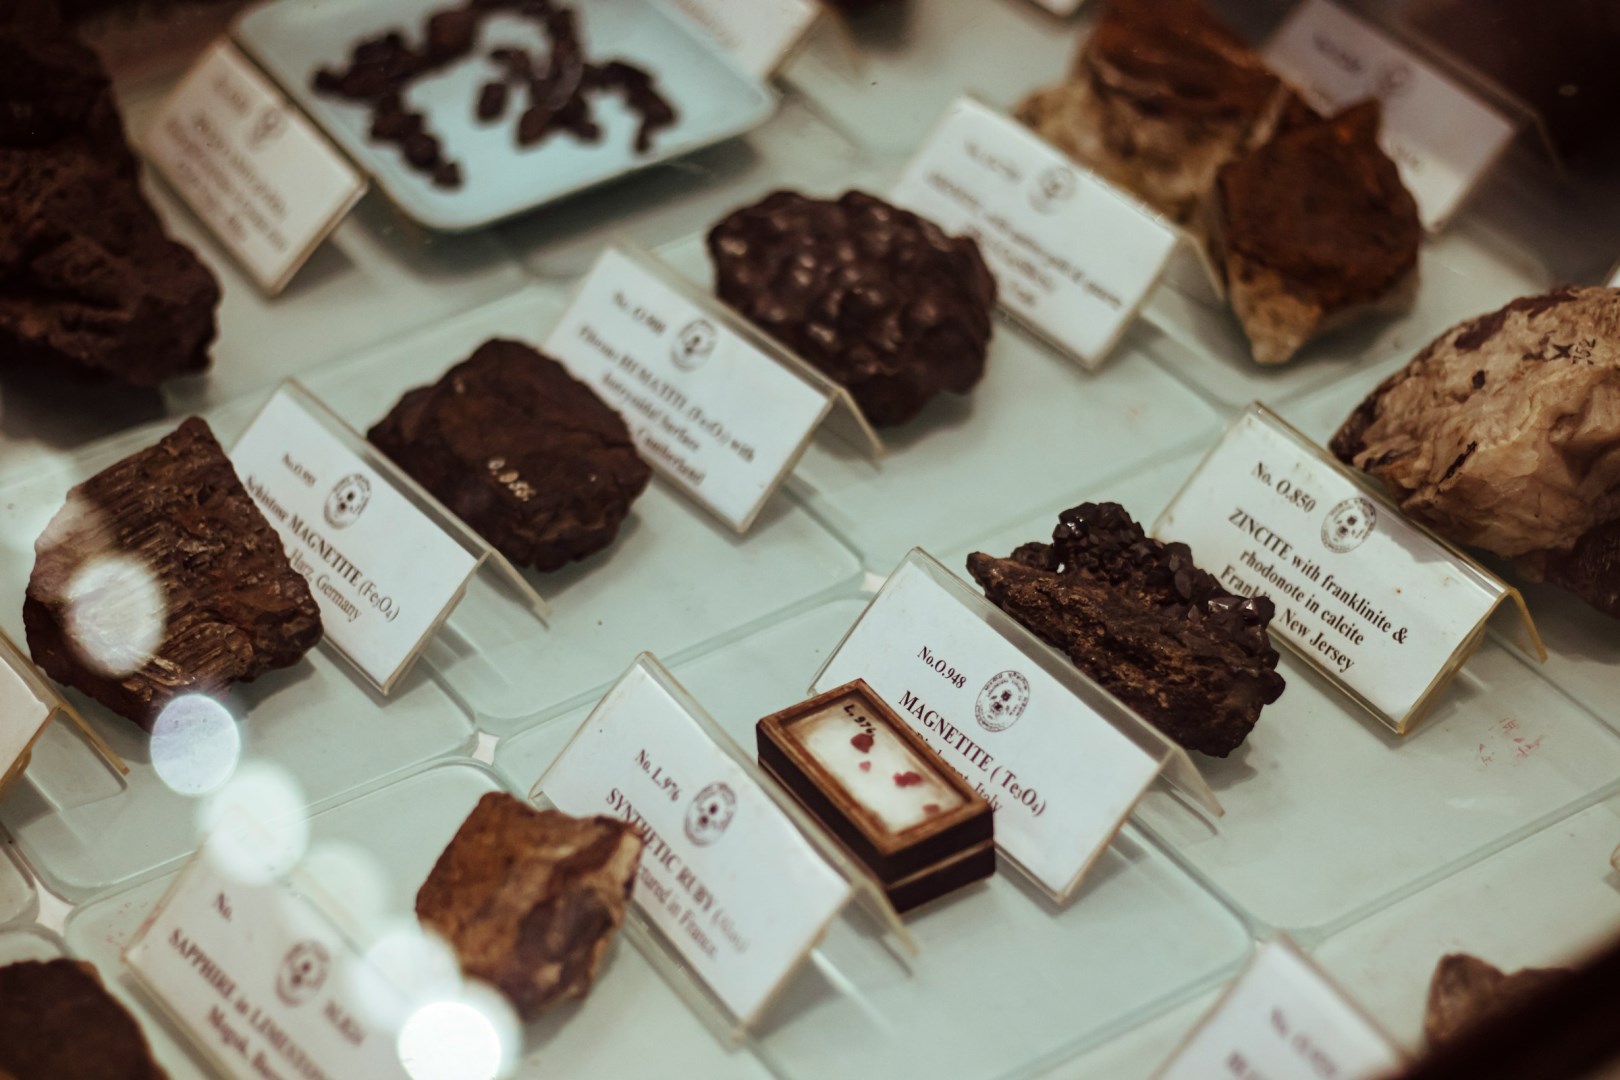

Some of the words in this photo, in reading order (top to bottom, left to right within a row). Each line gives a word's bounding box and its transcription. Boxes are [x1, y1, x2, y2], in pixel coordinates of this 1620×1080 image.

[1275, 479, 1317, 513] O.850
[289, 512, 363, 587] MAGNETITE
[1228, 508, 1292, 559] ZINCITE
[1293, 555, 1321, 581] with
[1321, 577, 1391, 633] franklinite
[1392, 627, 1409, 643] &
[316, 575, 363, 622] Germany
[1240, 549, 1305, 601] rhodonote
[1306, 595, 1321, 613] in
[1321, 609, 1365, 646] calcite
[1279, 608, 1309, 637] New
[1310, 631, 1355, 673] Jersey
[898, 689, 995, 774] MAGNETITE
